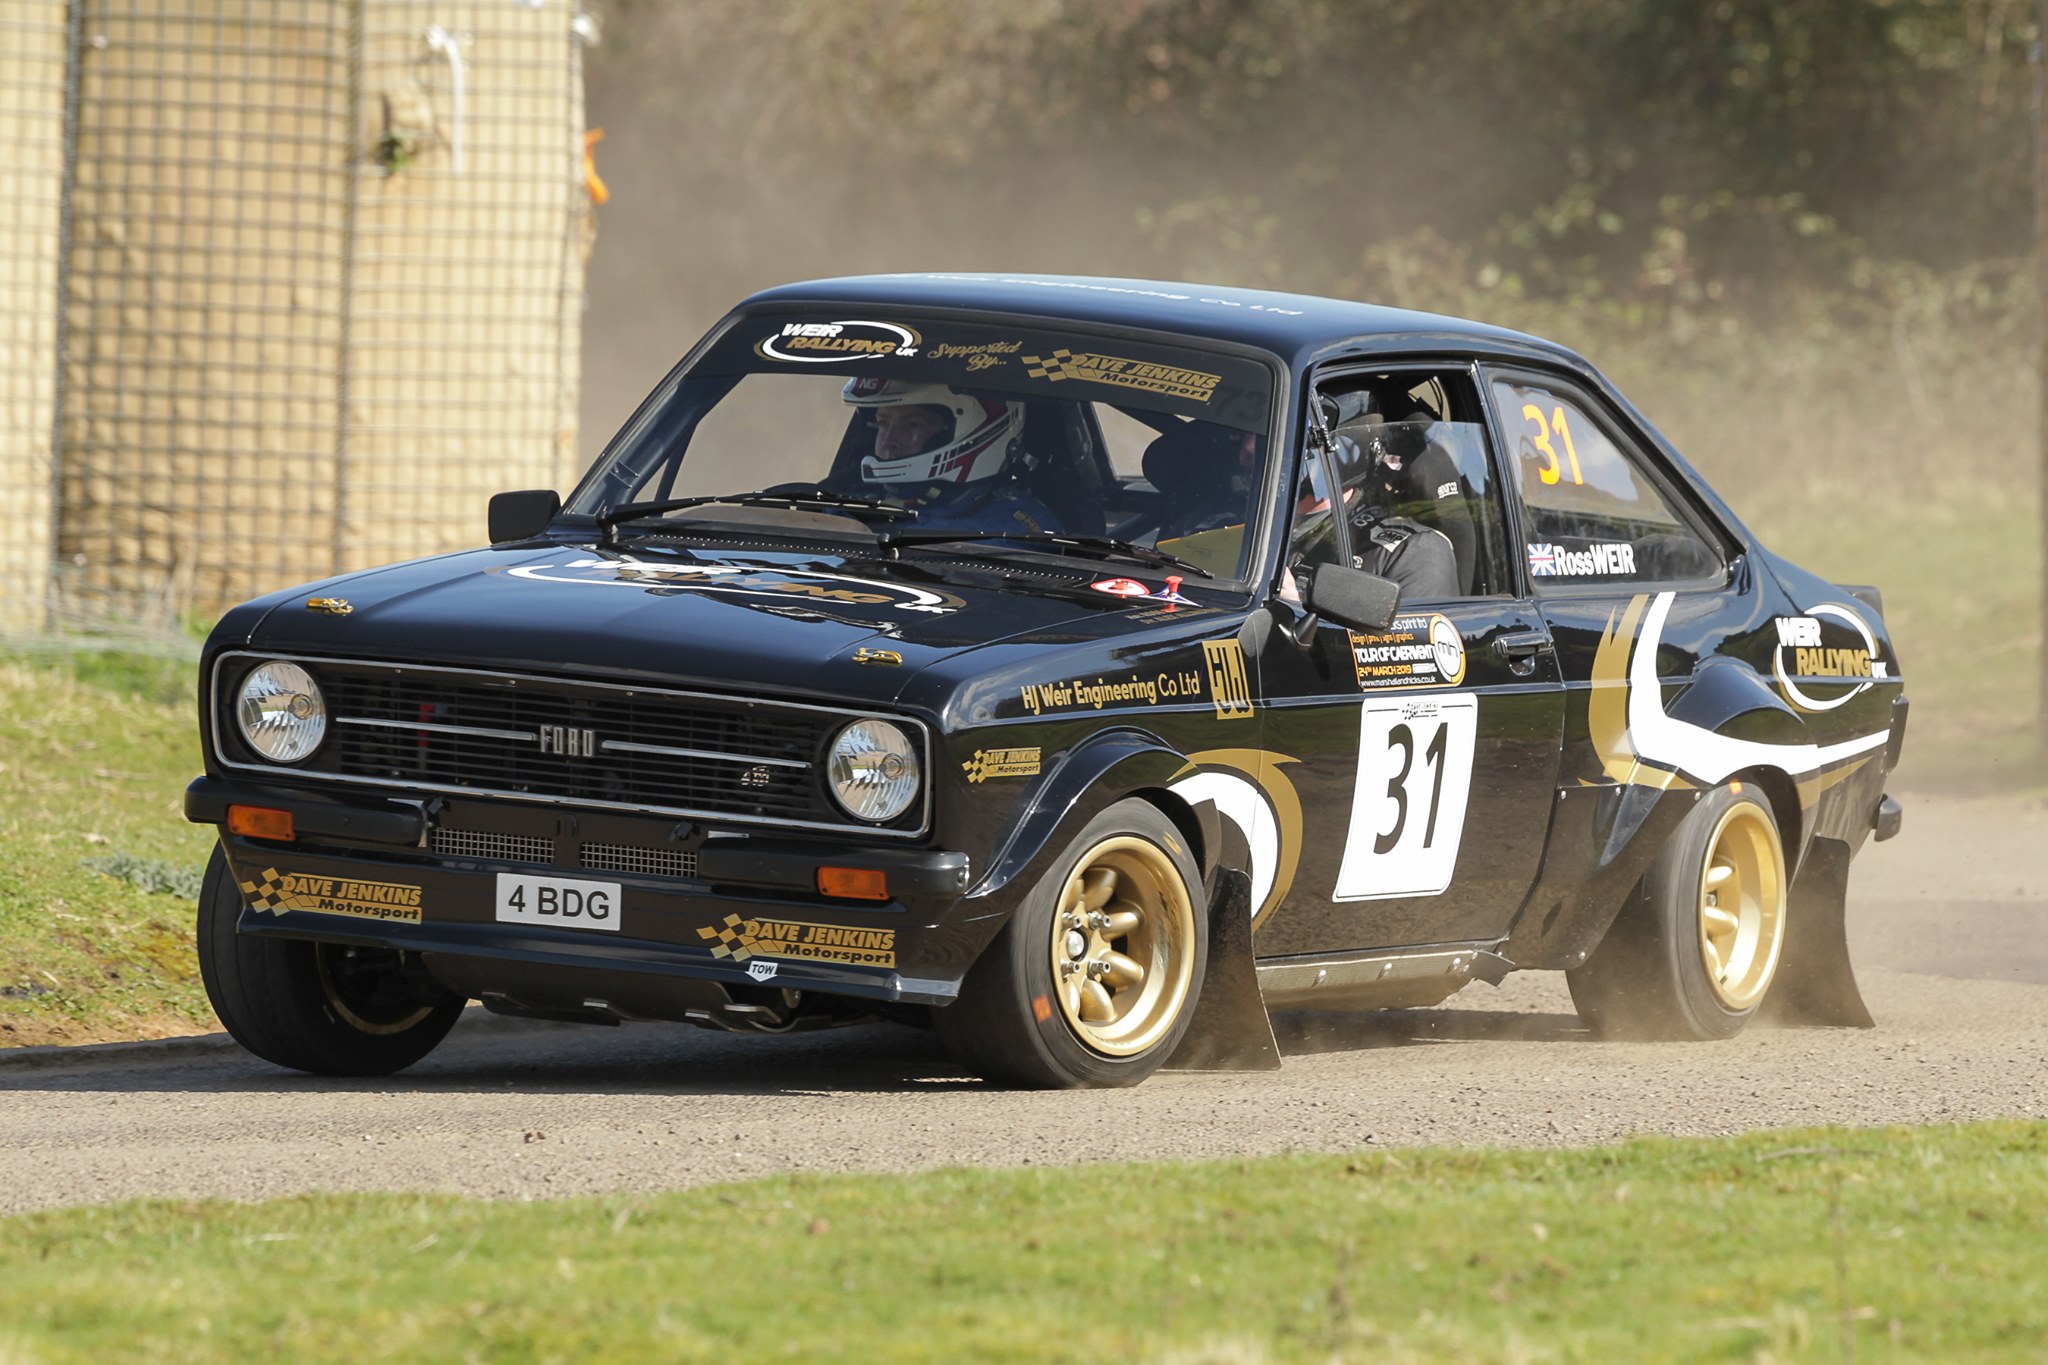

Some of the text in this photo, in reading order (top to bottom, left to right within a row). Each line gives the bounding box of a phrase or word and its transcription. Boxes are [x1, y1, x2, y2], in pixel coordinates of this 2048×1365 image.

[781, 323, 844, 337] WEIR
[785, 336, 918, 357] RALLYING UK
[927, 341, 1023, 359] Supported
[1070, 353, 1222, 389] DAVE JENKINS
[1101, 372, 1208, 398] Motorsport
[1522, 404, 1584, 486] 31
[1775, 617, 1822, 647] WEIR
[1354, 647, 1379, 663] TOUR
[1378, 646, 1390, 662] OF
[1795, 647, 1888, 679] RALLYING UK
[1372, 665, 1397, 676] MARCH
[1396, 664, 1412, 674] 2019
[1020, 670, 1200, 716] HJ Weir Engineering Co Ltd
[540, 724, 597, 758] FORD
[997, 764, 1039, 774] Motorsport
[1005, 750, 1041, 763] JENKINS
[1373, 721, 1449, 855] 31
[280, 876, 422, 906] DAVE JENKINS
[508, 884, 609, 920] 4 BDG
[318, 898, 419, 920] Motorsport
[743, 919, 896, 950] DAVE JENKINS
[783, 943, 892, 964] Motorsport
[752, 963, 777, 976] TOW
